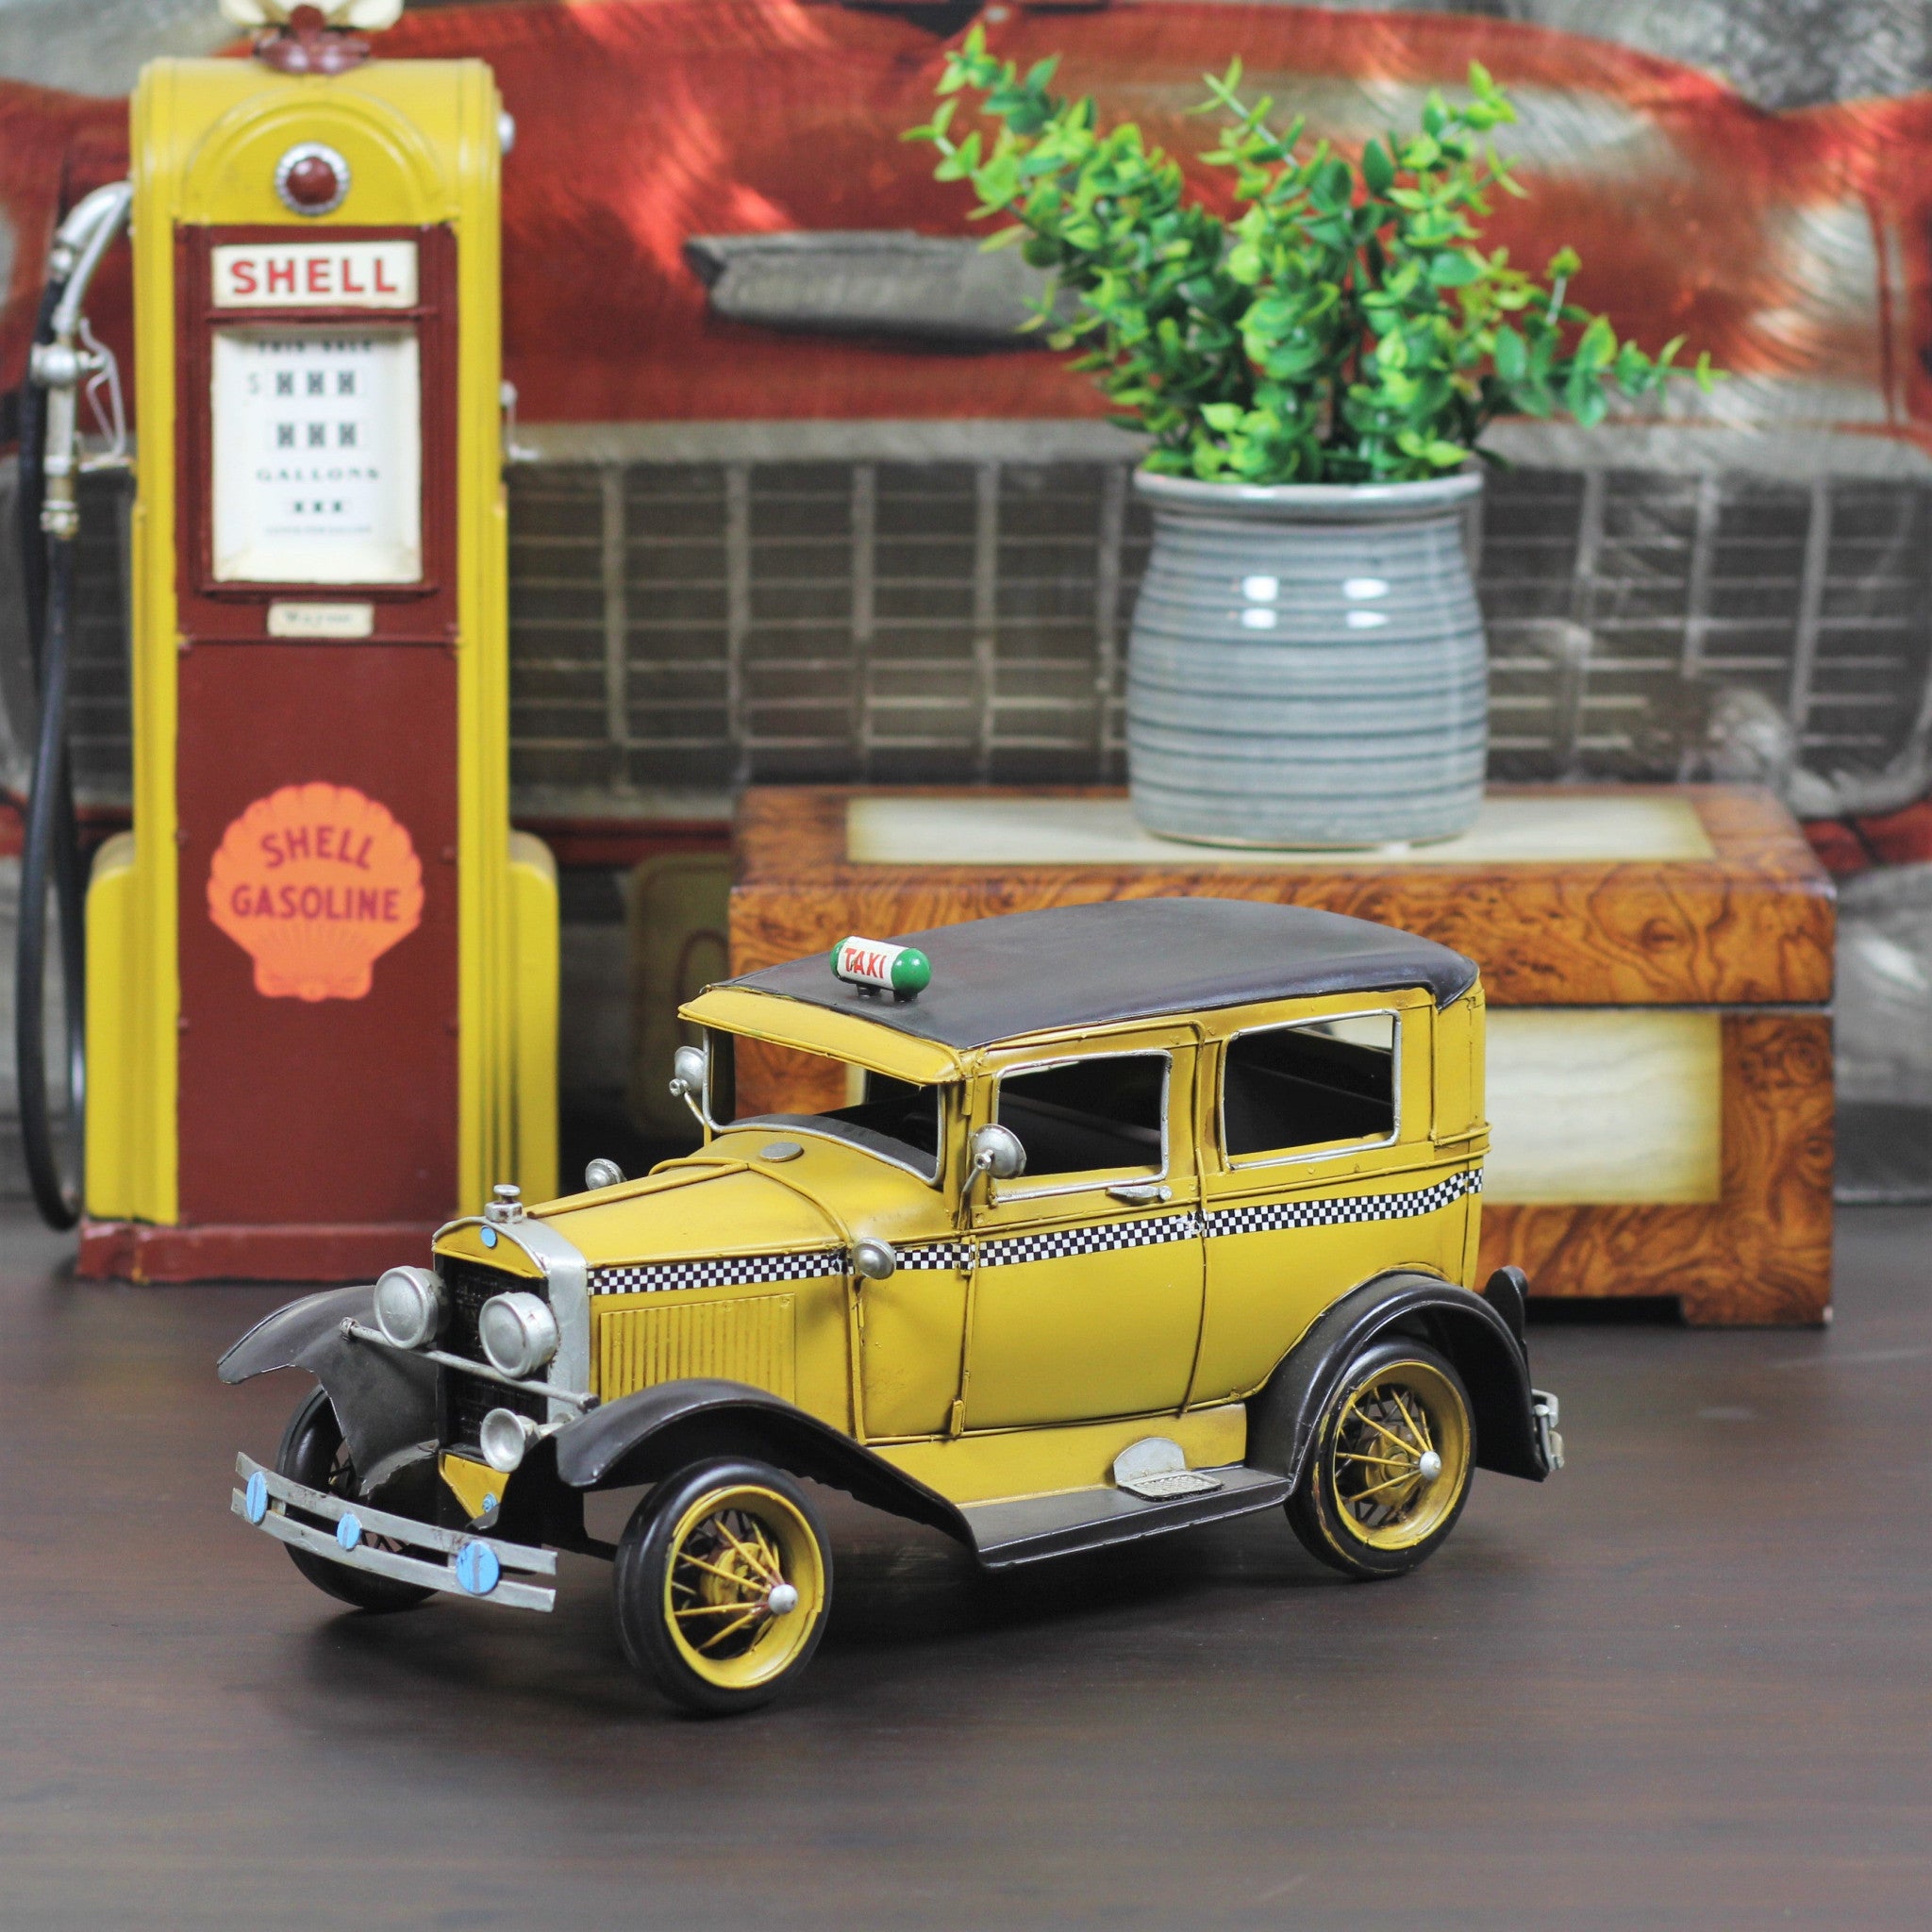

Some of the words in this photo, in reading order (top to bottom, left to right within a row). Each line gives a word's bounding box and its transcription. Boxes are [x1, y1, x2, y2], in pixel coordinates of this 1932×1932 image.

[230, 258, 397, 295] SHELL
[260, 824, 375, 871] SHELL
[230, 883, 401, 923] GASOLINE
